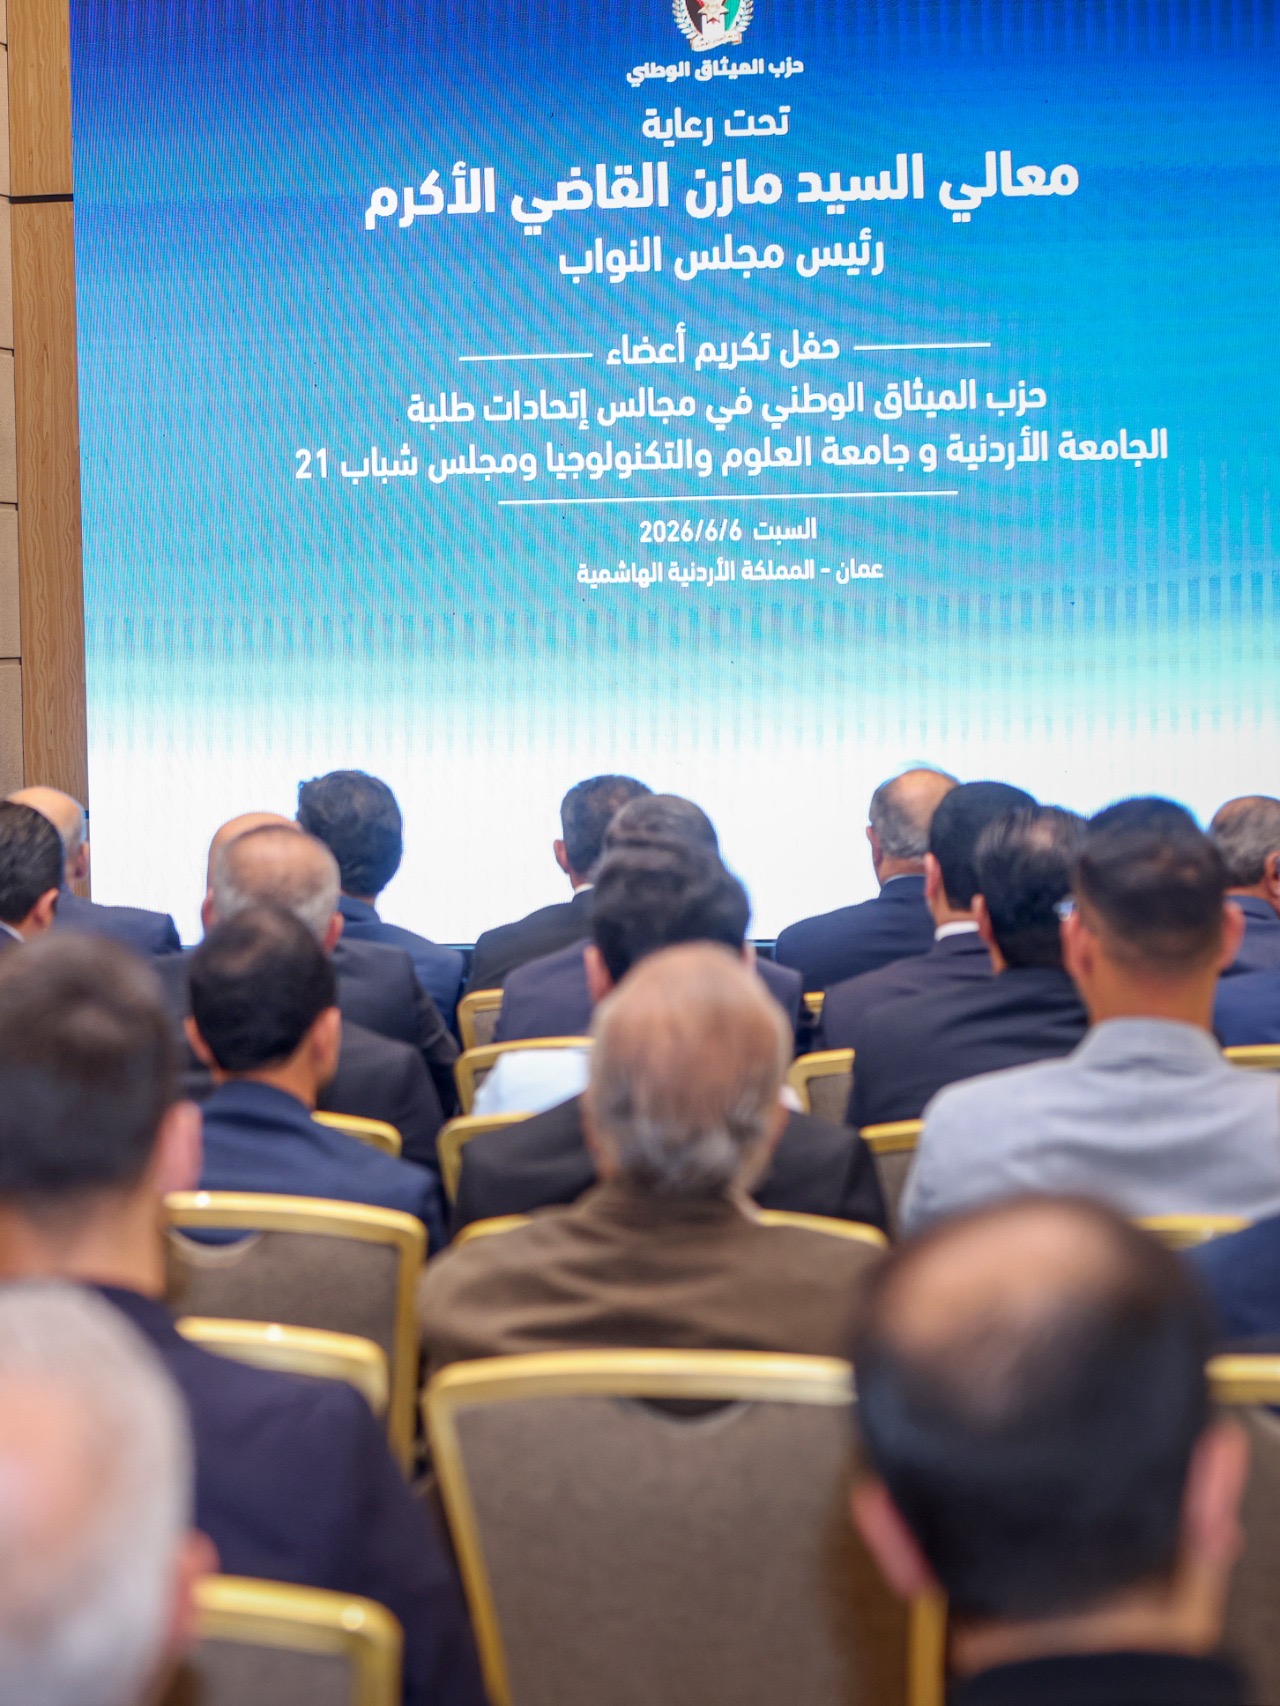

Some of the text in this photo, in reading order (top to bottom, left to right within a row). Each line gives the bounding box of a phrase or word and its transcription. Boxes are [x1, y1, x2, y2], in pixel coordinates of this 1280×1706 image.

[626, 56, 805, 88] حزب الميثاق الوطني
[643, 106, 791, 149] تحت رعاية
[366, 151, 1080, 237] معالي السيد مازن القاضي الأكرم
[560, 228, 885, 285] رئيس مجلس النواب
[606, 322, 841, 372] حفل تكريم أعضاء
[408, 377, 1048, 433] حزب الميثاق الوطني في مجالس إتحادات طلبة
[296, 426, 1169, 486] الجامعة الأردنية و جامعة العلوم والتكنولوجيا ومجلس شباب 21
[640, 517, 819, 546] السبت 2026/6/6
[577, 560, 665, 591] الهاشمية
[668, 556, 737, 590] الأردنية
[741, 558, 817, 582] المملكة
[836, 558, 885, 586] عمان
